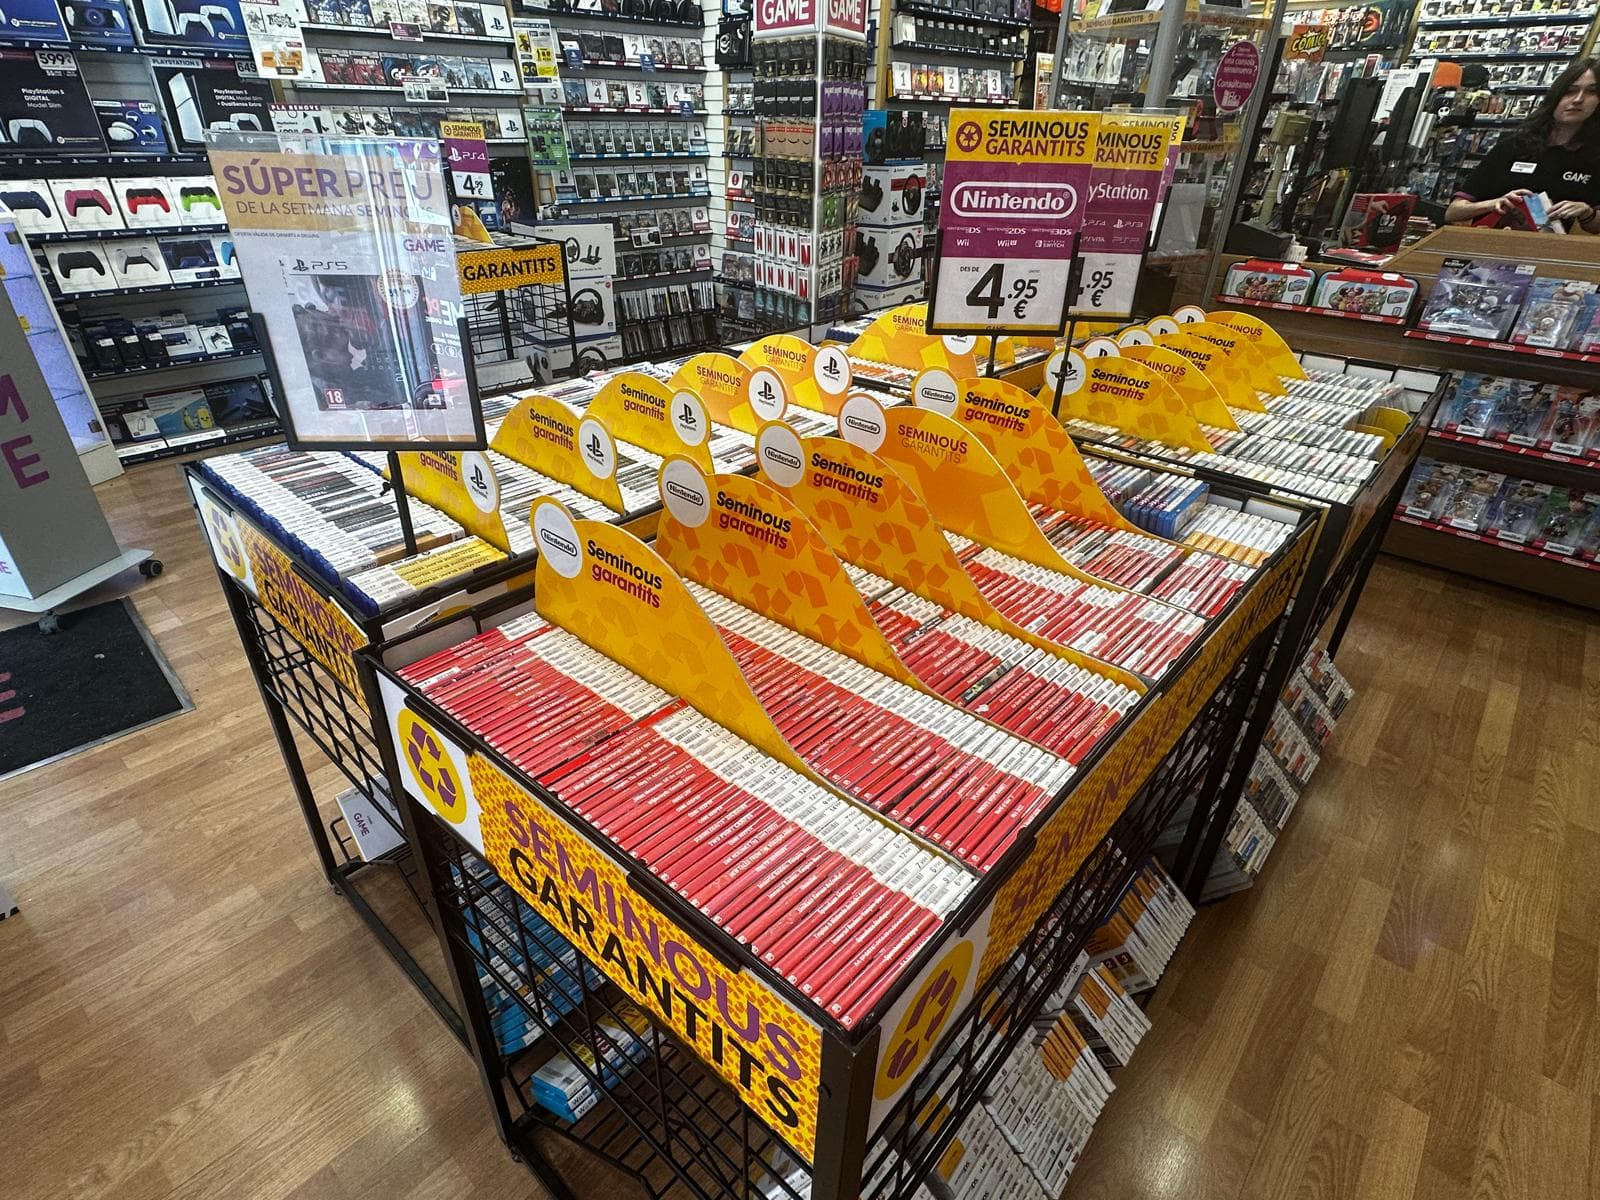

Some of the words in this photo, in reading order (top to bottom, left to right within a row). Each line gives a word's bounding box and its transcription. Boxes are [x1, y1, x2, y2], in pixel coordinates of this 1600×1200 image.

[762, 0, 810, 25] GAME
[829, 0, 861, 25] GAME
[631, 43, 640, 56] 2
[238, 62, 257, 72] 649
[899, 73, 906, 86] 1
[551, 88, 559, 100] 3
[594, 87, 602, 100] 4
[635, 89, 642, 102] 5
[451, 124, 481, 134] SEMINOUS
[987, 120, 1089, 140] SEMINOUS
[985, 138, 1086, 158] GARANTITS
[1096, 131, 1162, 150] MINOUS
[462, 151, 486, 160] PS4
[1095, 148, 1159, 165] RANTITS
[222, 159, 343, 198] SÚPER
[344, 169, 433, 201] PREU
[1563, 171, 1592, 185] GAME
[961, 190, 1065, 211] Nintendo
[1088, 182, 1149, 203] yStation
[236, 201, 257, 214] DE
[260, 202, 280, 215] LA
[281, 203, 354, 218] SETMANA
[403, 238, 445, 253] GAME
[956, 239, 970, 247] Wii
[311, 260, 348, 271] PS5
[463, 256, 557, 282] GARANTITS
[1013, 299, 1028, 319] €
[1091, 289, 1105, 308] €
[892, 314, 925, 326] SEMINO
[763, 344, 807, 364] SEMINOUS
[696, 365, 741, 387] SEMINOUS
[1091, 368, 1151, 389] Seminous
[326, 390, 344, 404] 18
[620, 383, 666, 409] Seminous
[924, 390, 953, 401] Nintendo
[1090, 380, 1145, 401] garantits
[623, 398, 665, 422] garantits
[965, 391, 1030, 419] Seminous
[529, 407, 574, 437] Seminous
[848, 419, 878, 433] Nintendo
[965, 407, 1026, 433] garantits
[533, 424, 574, 451] garantits
[898, 424, 968, 454] SEMINOUS
[767, 449, 798, 467] Nintendo
[901, 438, 962, 464] GARANTITS
[420, 453, 458, 481] garantits
[811, 453, 884, 488] Seminous
[669, 483, 701, 504] Nintendo
[813, 472, 879, 504] garantits
[716, 491, 791, 534] Seminous
[719, 512, 789, 550] garantits
[543, 532, 576, 556] Nintendo
[588, 540, 663, 590] Seminous
[592, 563, 661, 609] garantits
[254, 542, 354, 654] SEMINOUS
[264, 580, 357, 683] GARANTIT
[353, 812, 370, 837] GAME
[505, 800, 802, 1081] SEMINOUS
[509, 848, 800, 1129] GARANTITS
